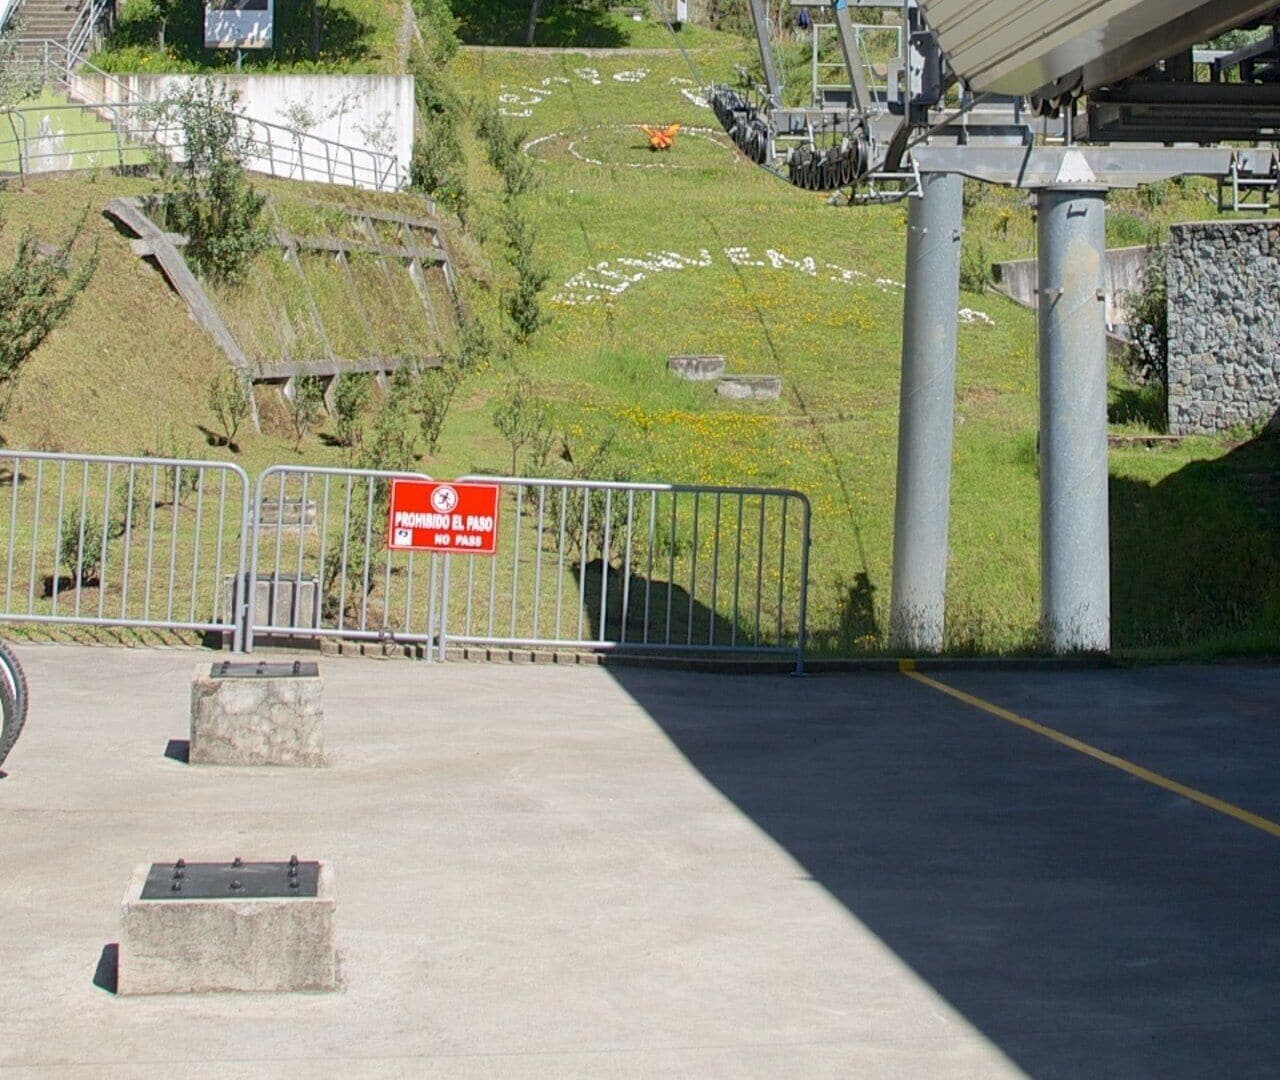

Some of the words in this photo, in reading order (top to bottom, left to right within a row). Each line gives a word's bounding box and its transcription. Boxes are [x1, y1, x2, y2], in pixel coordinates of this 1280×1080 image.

[395, 512, 451, 529] PROHIBIDO
[452, 515, 465, 531] EL
[466, 516, 493, 532] PASO
[434, 534, 451, 545] NO
[455, 535, 482, 547] PASS
